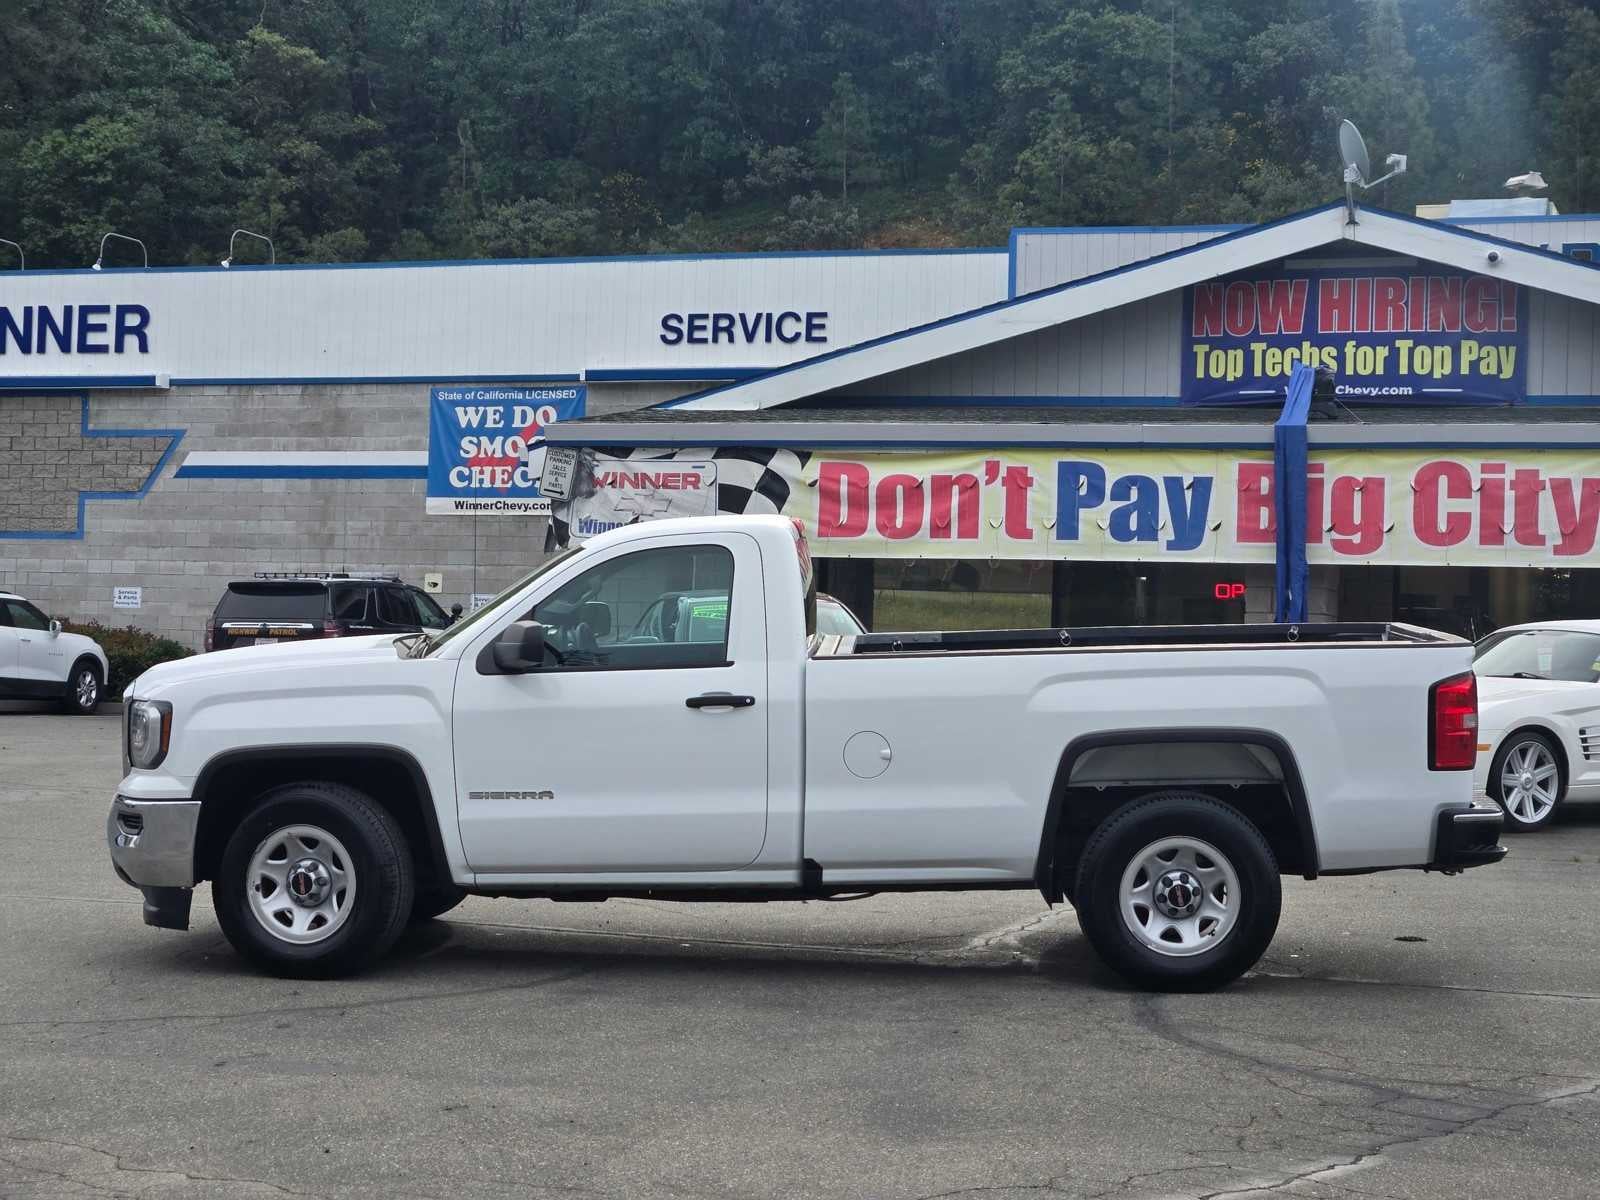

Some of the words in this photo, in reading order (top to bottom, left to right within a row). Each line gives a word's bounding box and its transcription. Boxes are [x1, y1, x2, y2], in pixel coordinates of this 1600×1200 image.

[1192, 279, 1309, 337] NOW
[1318, 276, 1517, 333] HIRING!
[0, 304, 150, 354] NNER
[659, 311, 828, 345] SERVICE
[1193, 344, 1244, 382] Top
[1344, 340, 1390, 376] for
[1395, 339, 1452, 379] Top
[1460, 339, 1517, 379] Pay
[438, 391, 463, 401] State
[464, 391, 474, 400] of
[477, 390, 523, 400] California
[525, 389, 577, 400] LICENSED
[1284, 385, 1413, 397] Chevy.com
[454, 406, 505, 428] WE
[512, 405, 558, 428] DO
[449, 466, 542, 488] CHEC
[592, 471, 701, 490] WINNER
[817, 460, 1034, 540] Don't
[1055, 461, 1214, 551] Pay
[1236, 462, 1385, 556] Big
[1413, 460, 1600, 556] City
[227, 628, 259, 637] HIGHWAY
[269, 628, 298, 637] PATROL
[469, 790, 555, 800] SIERRA
